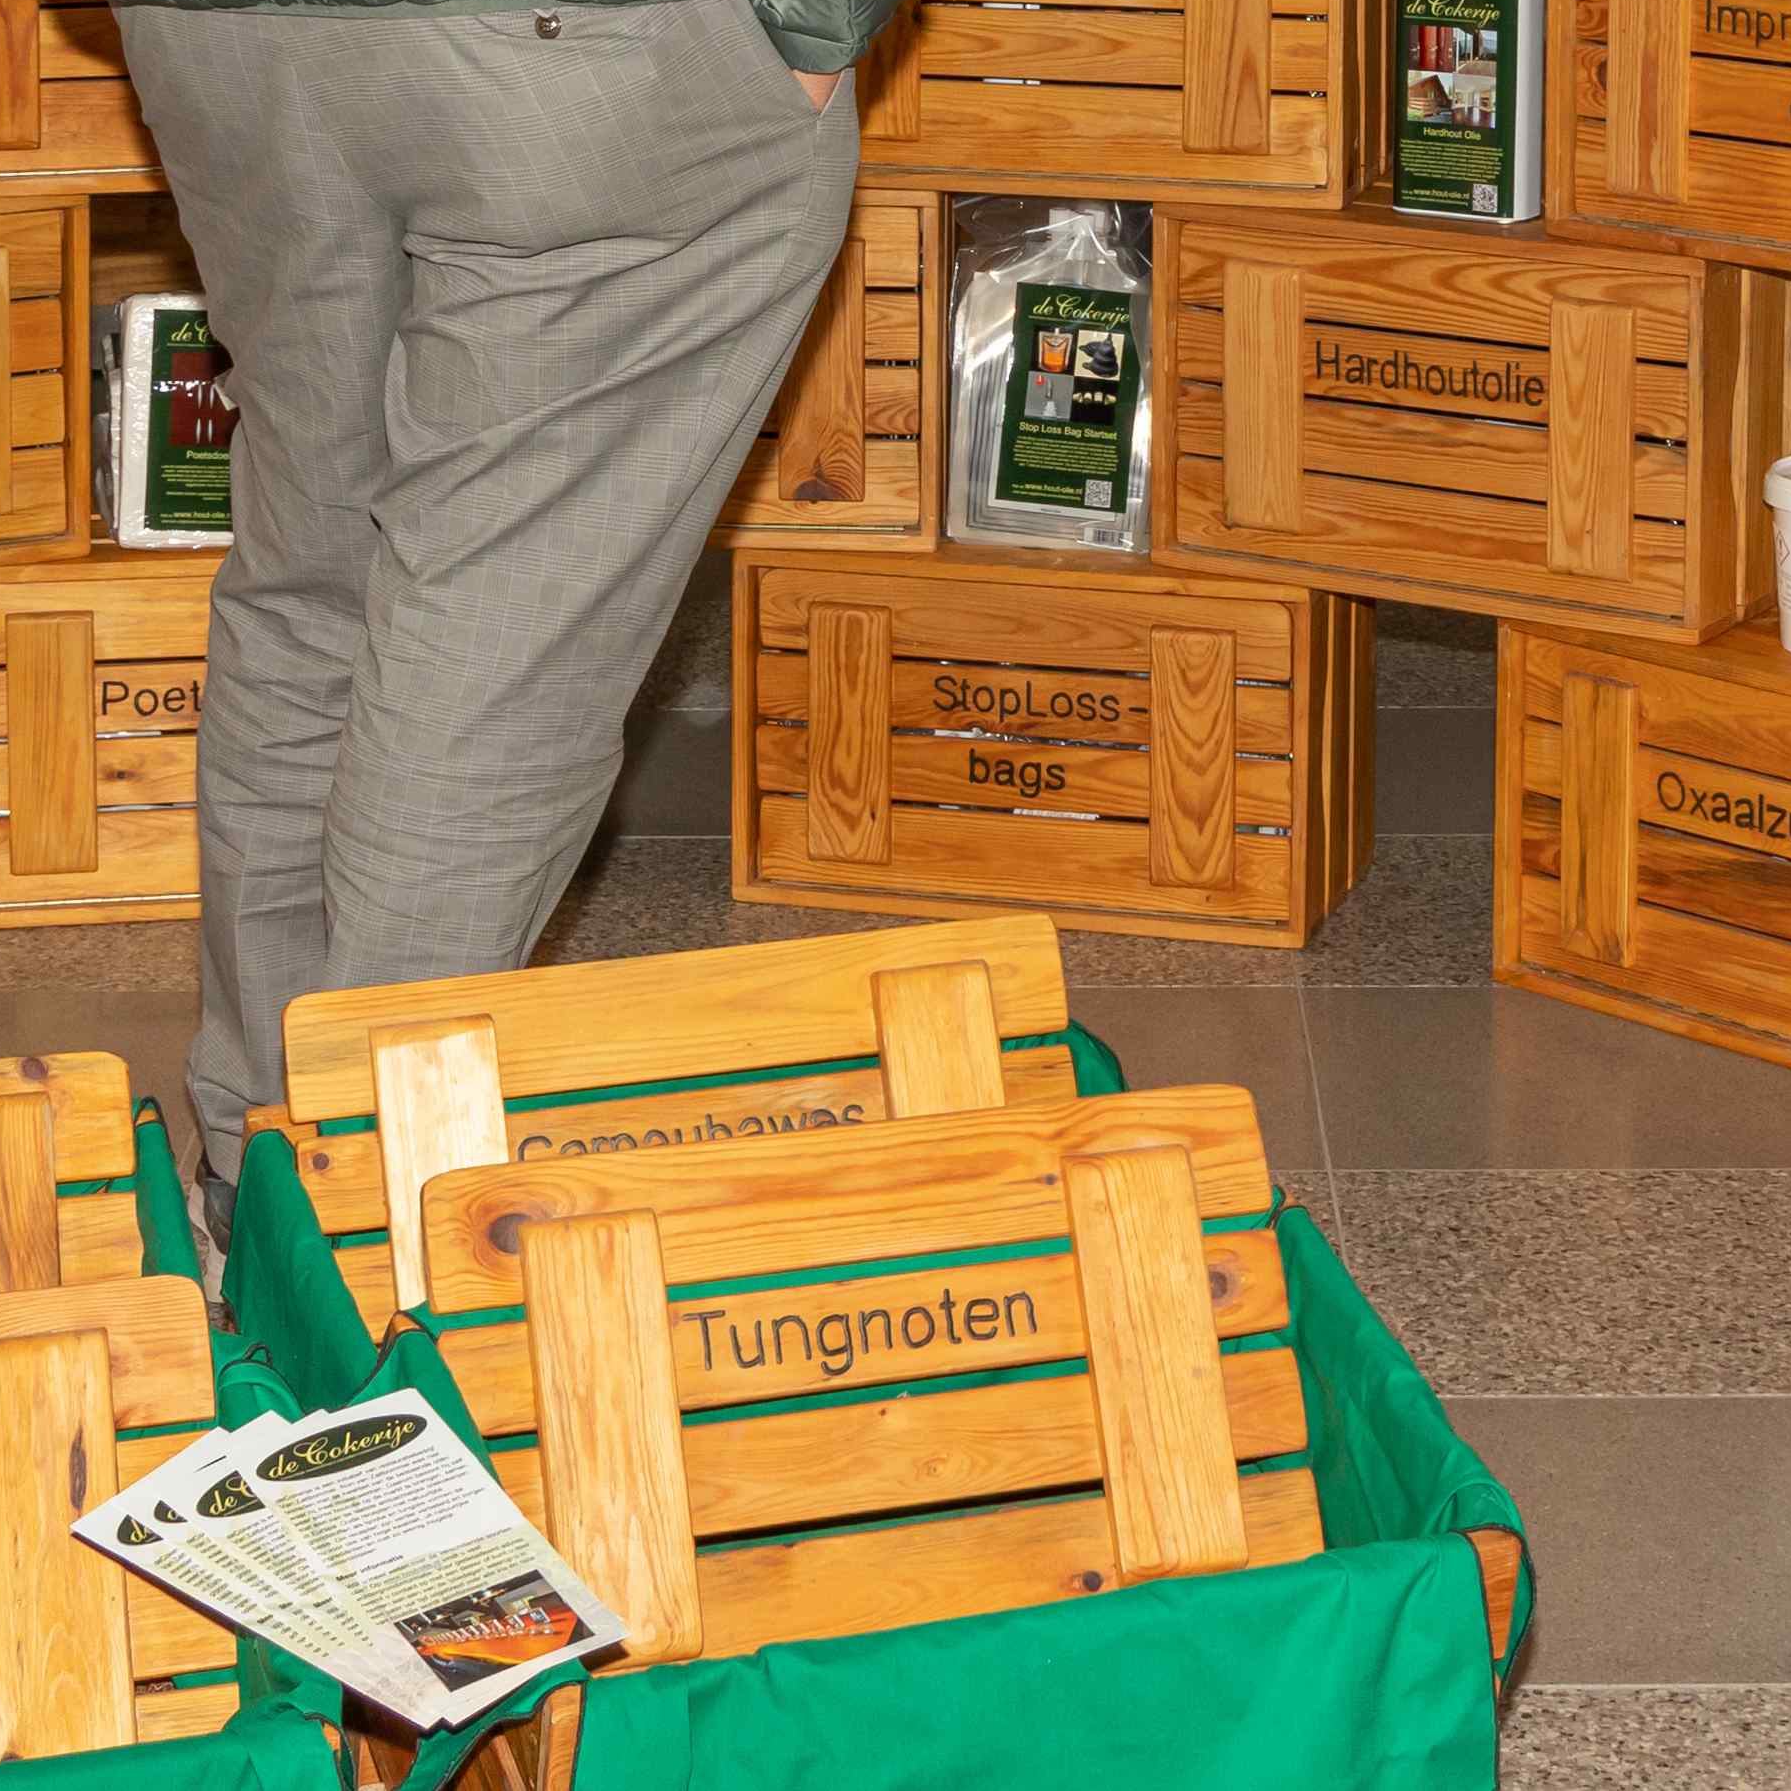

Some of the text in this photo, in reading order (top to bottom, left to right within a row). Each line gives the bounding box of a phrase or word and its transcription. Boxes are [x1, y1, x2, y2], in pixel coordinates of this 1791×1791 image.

[1423, 126, 1482, 141] Hardhout Olie
[1032, 296, 1053, 315] de
[171, 322, 193, 341] de
[1315, 340, 1545, 407] Hardhoutolie
[1019, 421, 1118, 440] Stop Loss Bag Startset
[186, 450, 230, 460] Poetsdoe
[101, 680, 202, 716] Poet
[968, 750, 1066, 798] bags
[683, 1288, 1037, 1379] Tungnoten
[268, 1419, 415, 1479] de Cokerije
[209, 1491, 237, 1516] de
